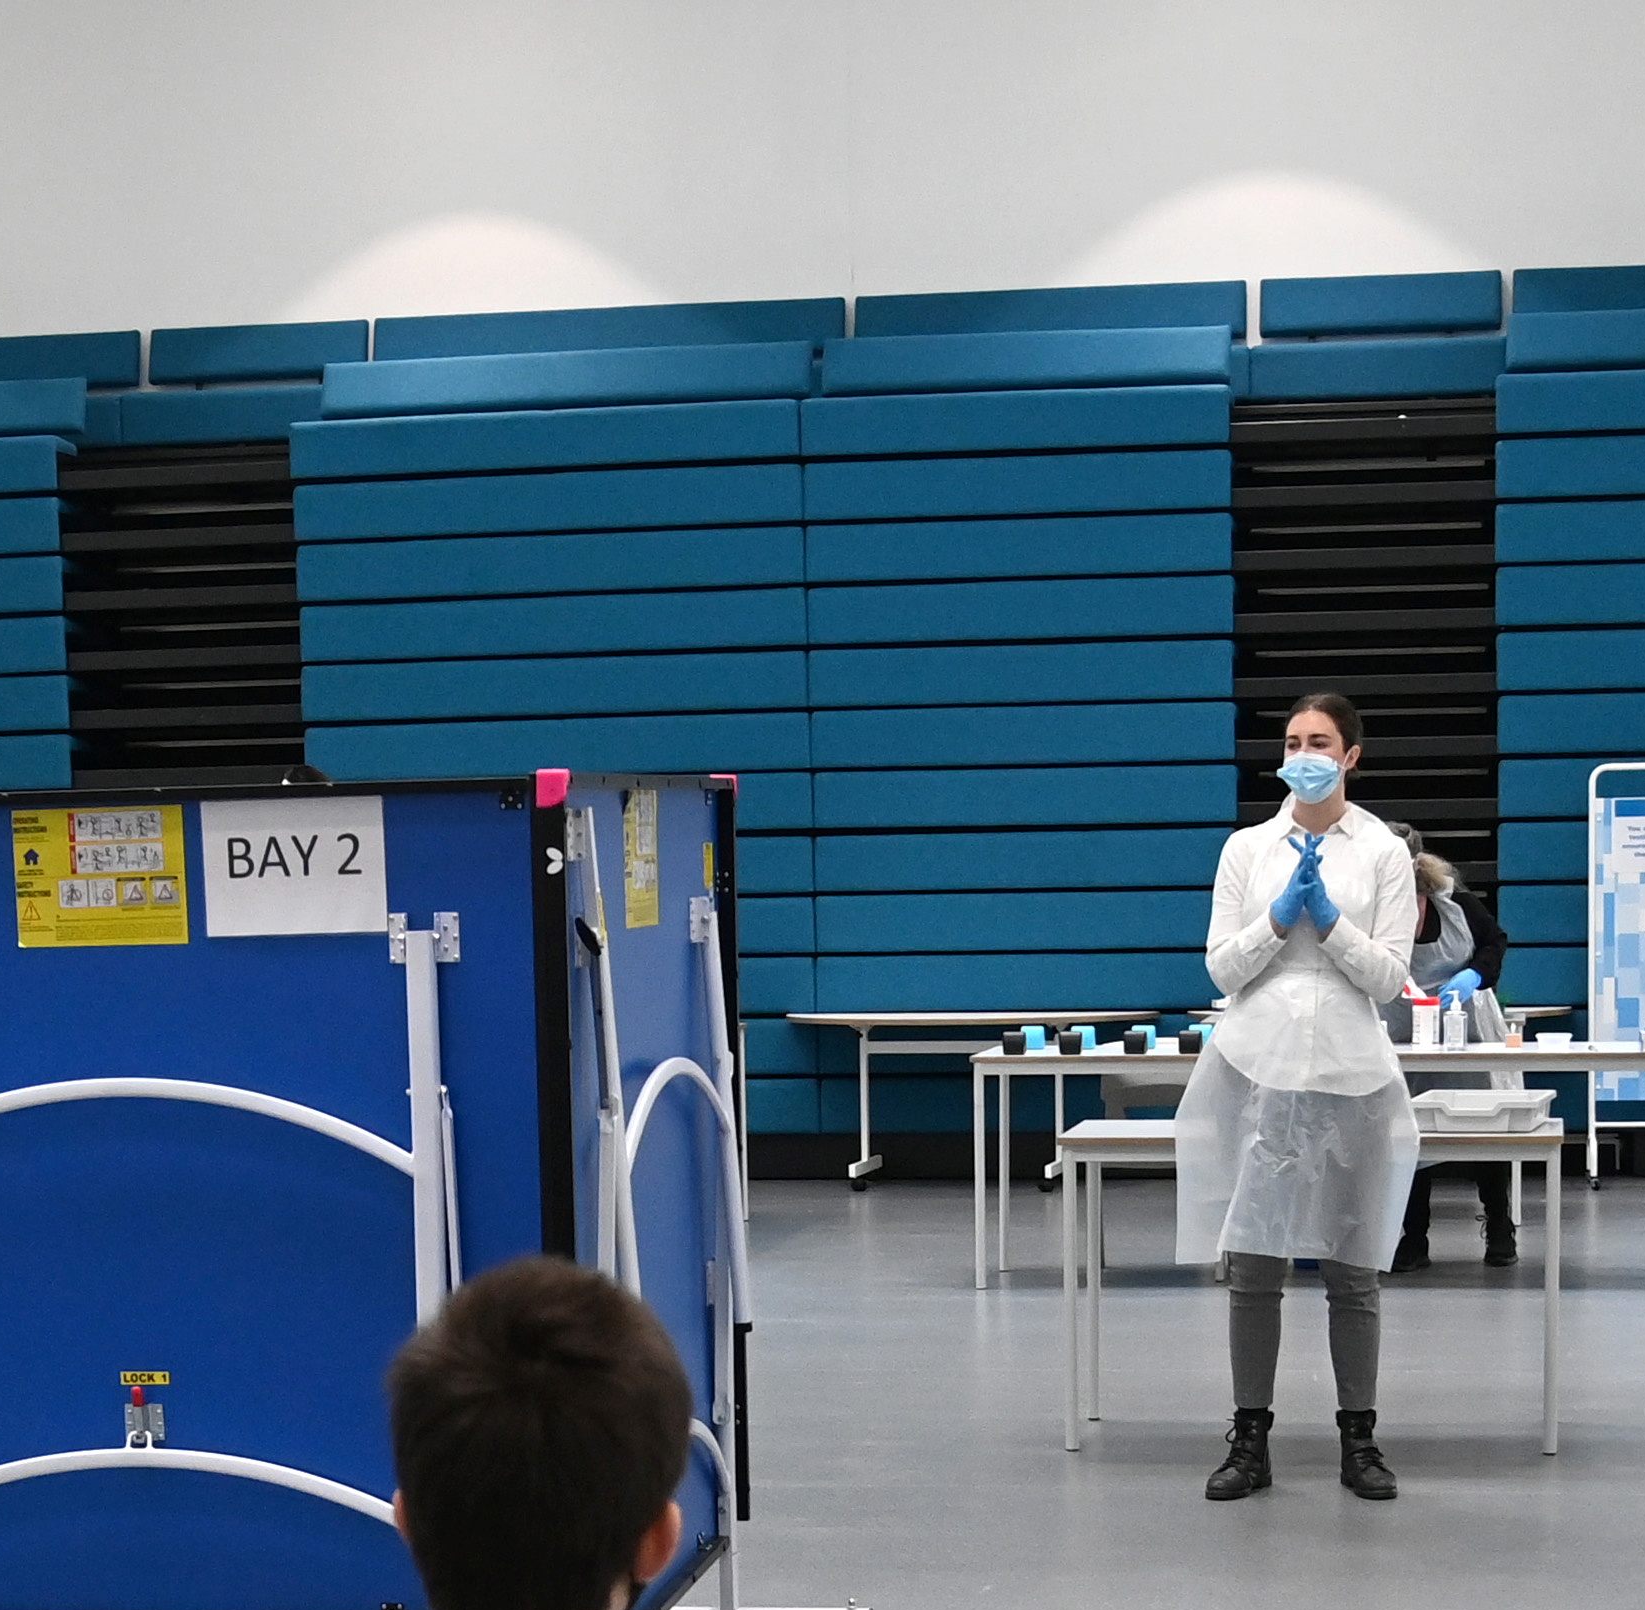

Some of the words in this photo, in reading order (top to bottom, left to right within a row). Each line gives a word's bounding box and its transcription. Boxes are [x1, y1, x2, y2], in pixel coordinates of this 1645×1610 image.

[227, 834, 319, 879] BAY
[336, 833, 363, 876] 2
[123, 1373, 156, 1383] LOCK
[161, 1374, 167, 1383] 1
